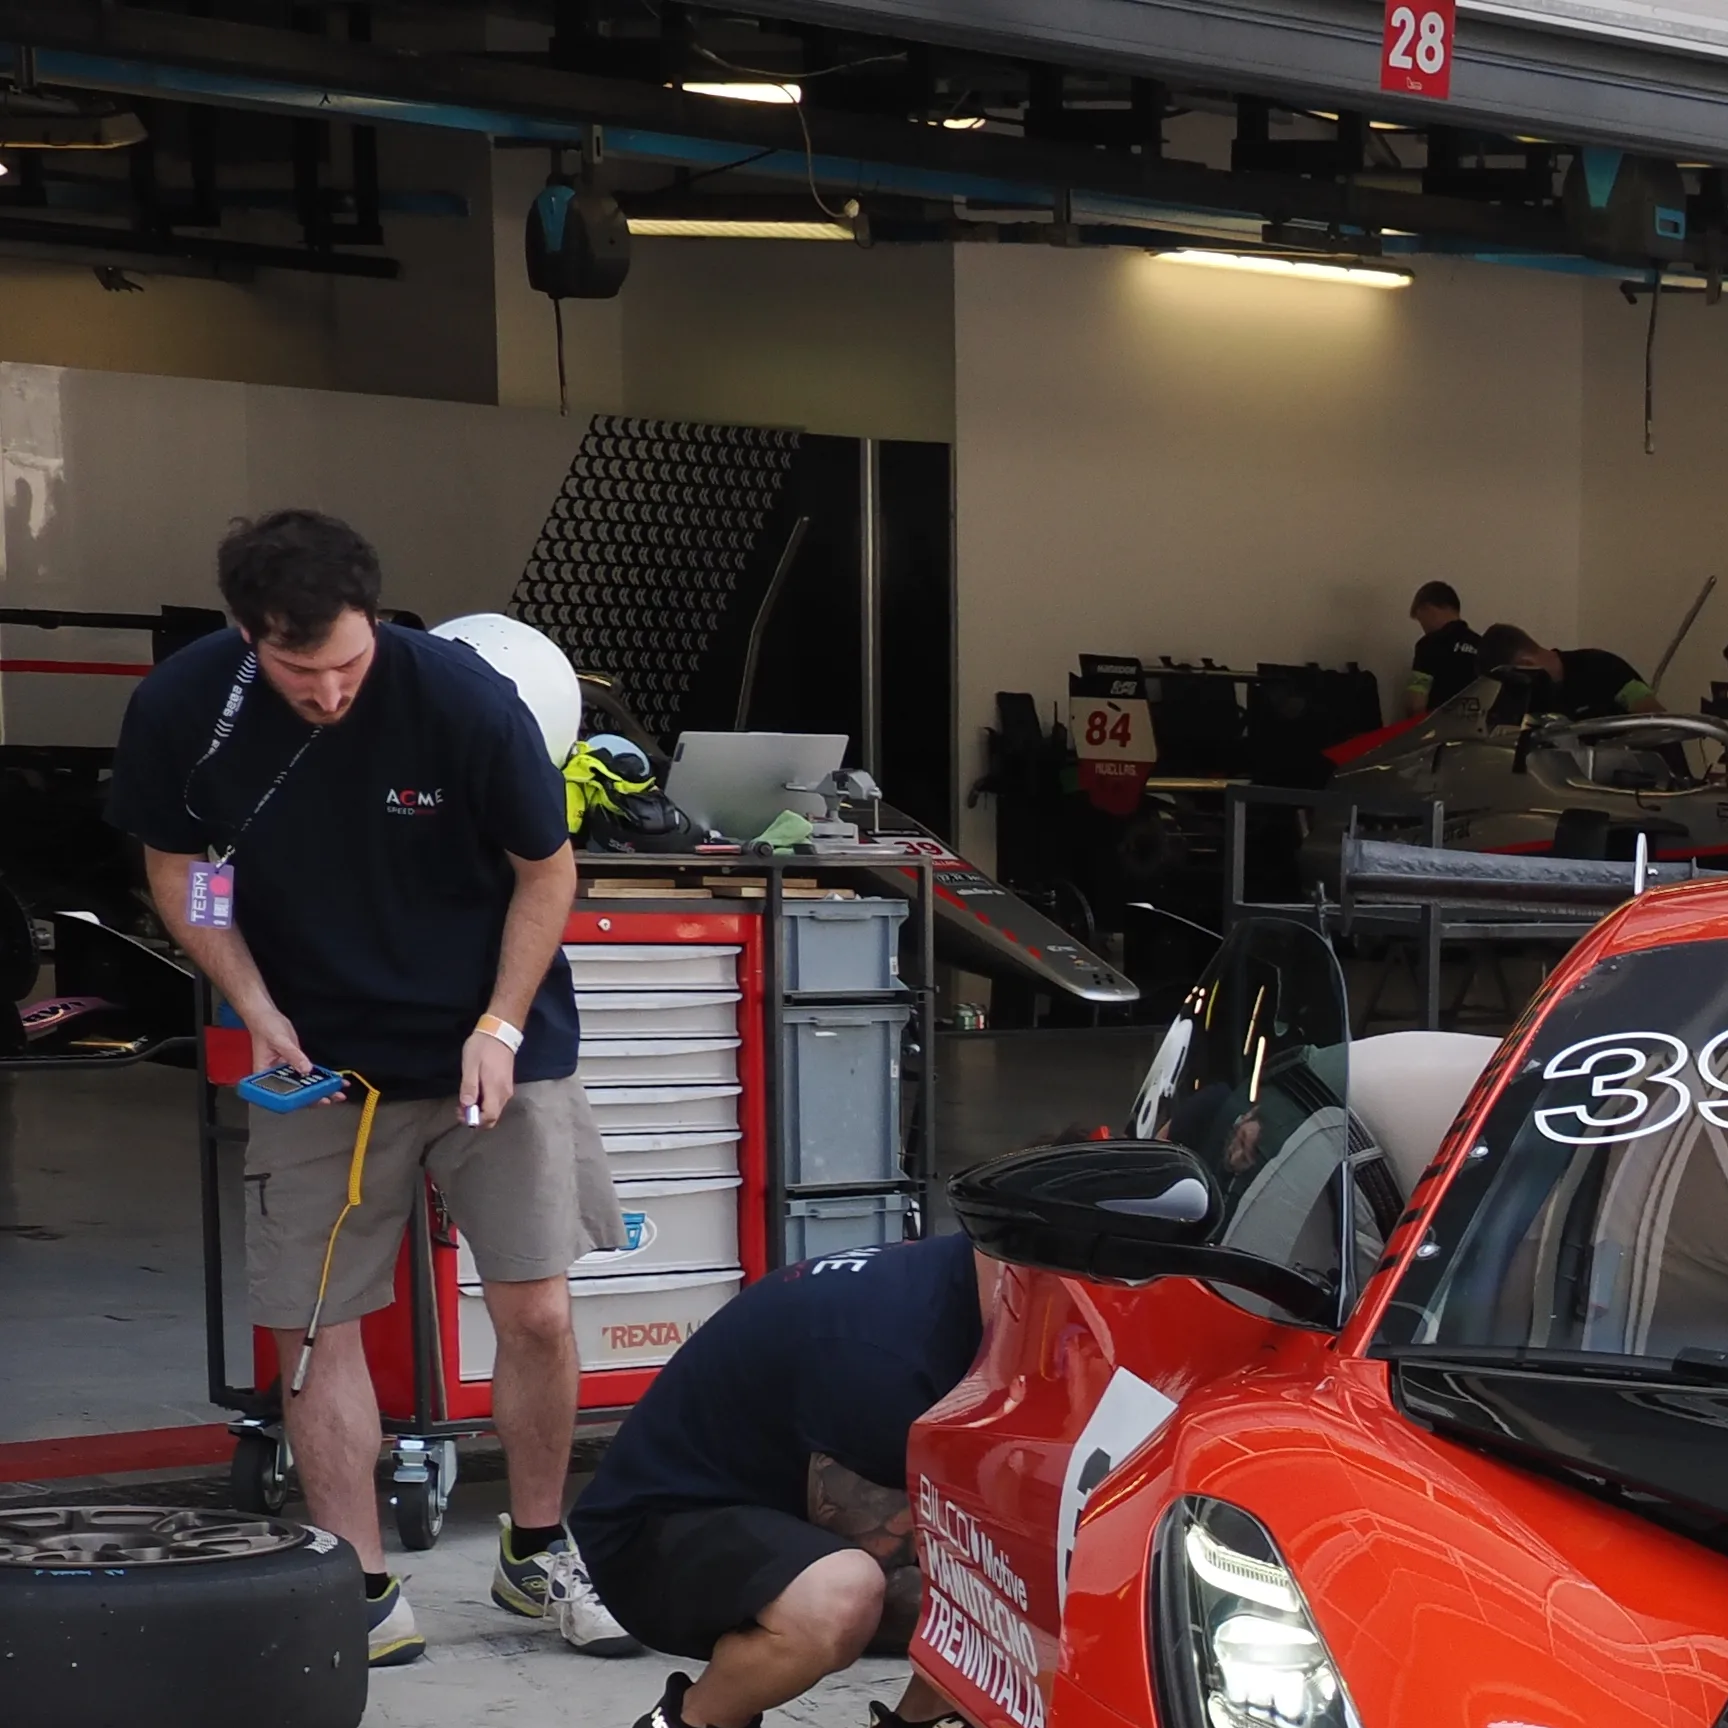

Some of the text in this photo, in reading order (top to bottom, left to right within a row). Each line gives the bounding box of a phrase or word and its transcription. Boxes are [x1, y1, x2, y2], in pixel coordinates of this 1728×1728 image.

[1389, 7, 1445, 74] 28
[1085, 711, 1131, 748] 84
[386, 788, 444, 807] ACME
[190, 872, 208, 922] TEAM
[919, 1473, 1027, 1612] BILCO Motive
[924, 1530, 1038, 1677] MANUTECNO
